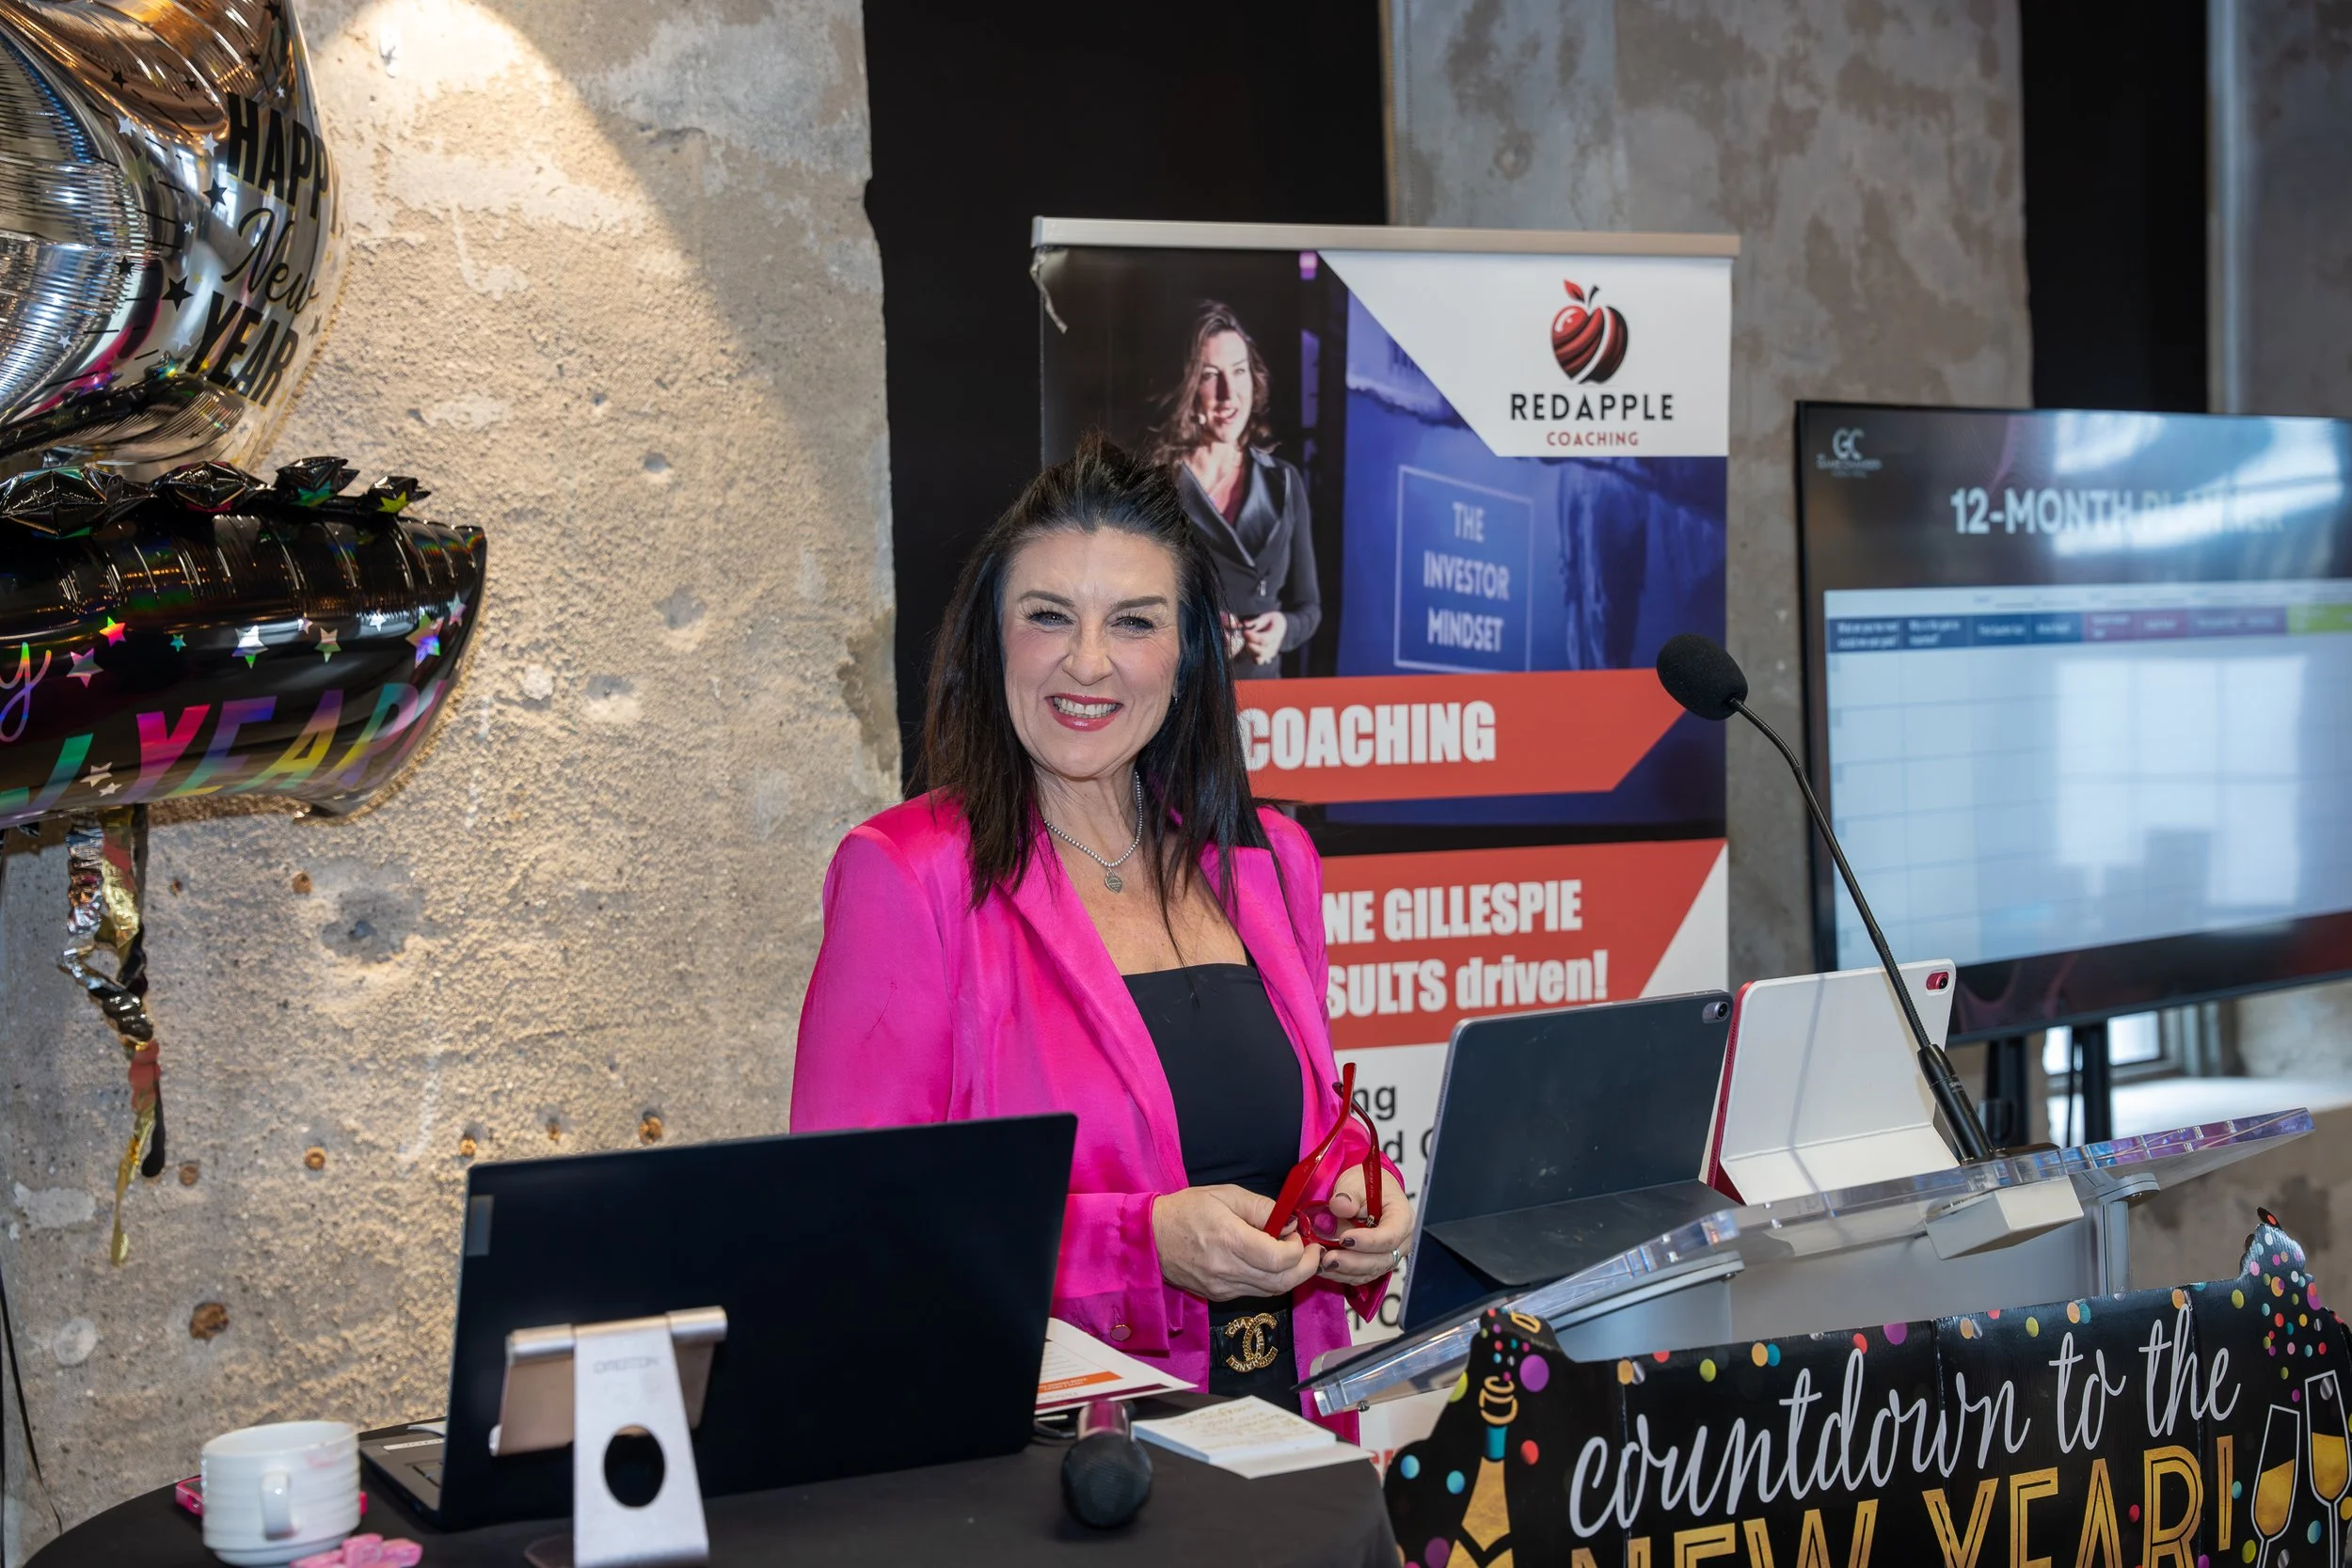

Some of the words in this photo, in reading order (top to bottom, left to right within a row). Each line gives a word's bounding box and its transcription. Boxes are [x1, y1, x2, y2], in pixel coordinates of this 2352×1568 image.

[222, 208, 319, 314] New
[185, 290, 299, 406] YEAR
[1510, 393, 1674, 421] REDAPPLE
[1546, 431, 1639, 447] COACHING
[1453, 501, 1486, 544] THE
[1949, 486, 2133, 535] 12-MONTH
[1423, 550, 1510, 601] INVESTOR
[1427, 607, 1504, 653] MINDSET
[1236, 701, 1497, 771] COACHING
[1383, 879, 1583, 942] GILLESPIE
[1455, 949, 1609, 1010] driven!
[1569, 1348, 2030, 1538] countdown
[2048, 1332, 2126, 1454] to
[2138, 1303, 2242, 1437] the
